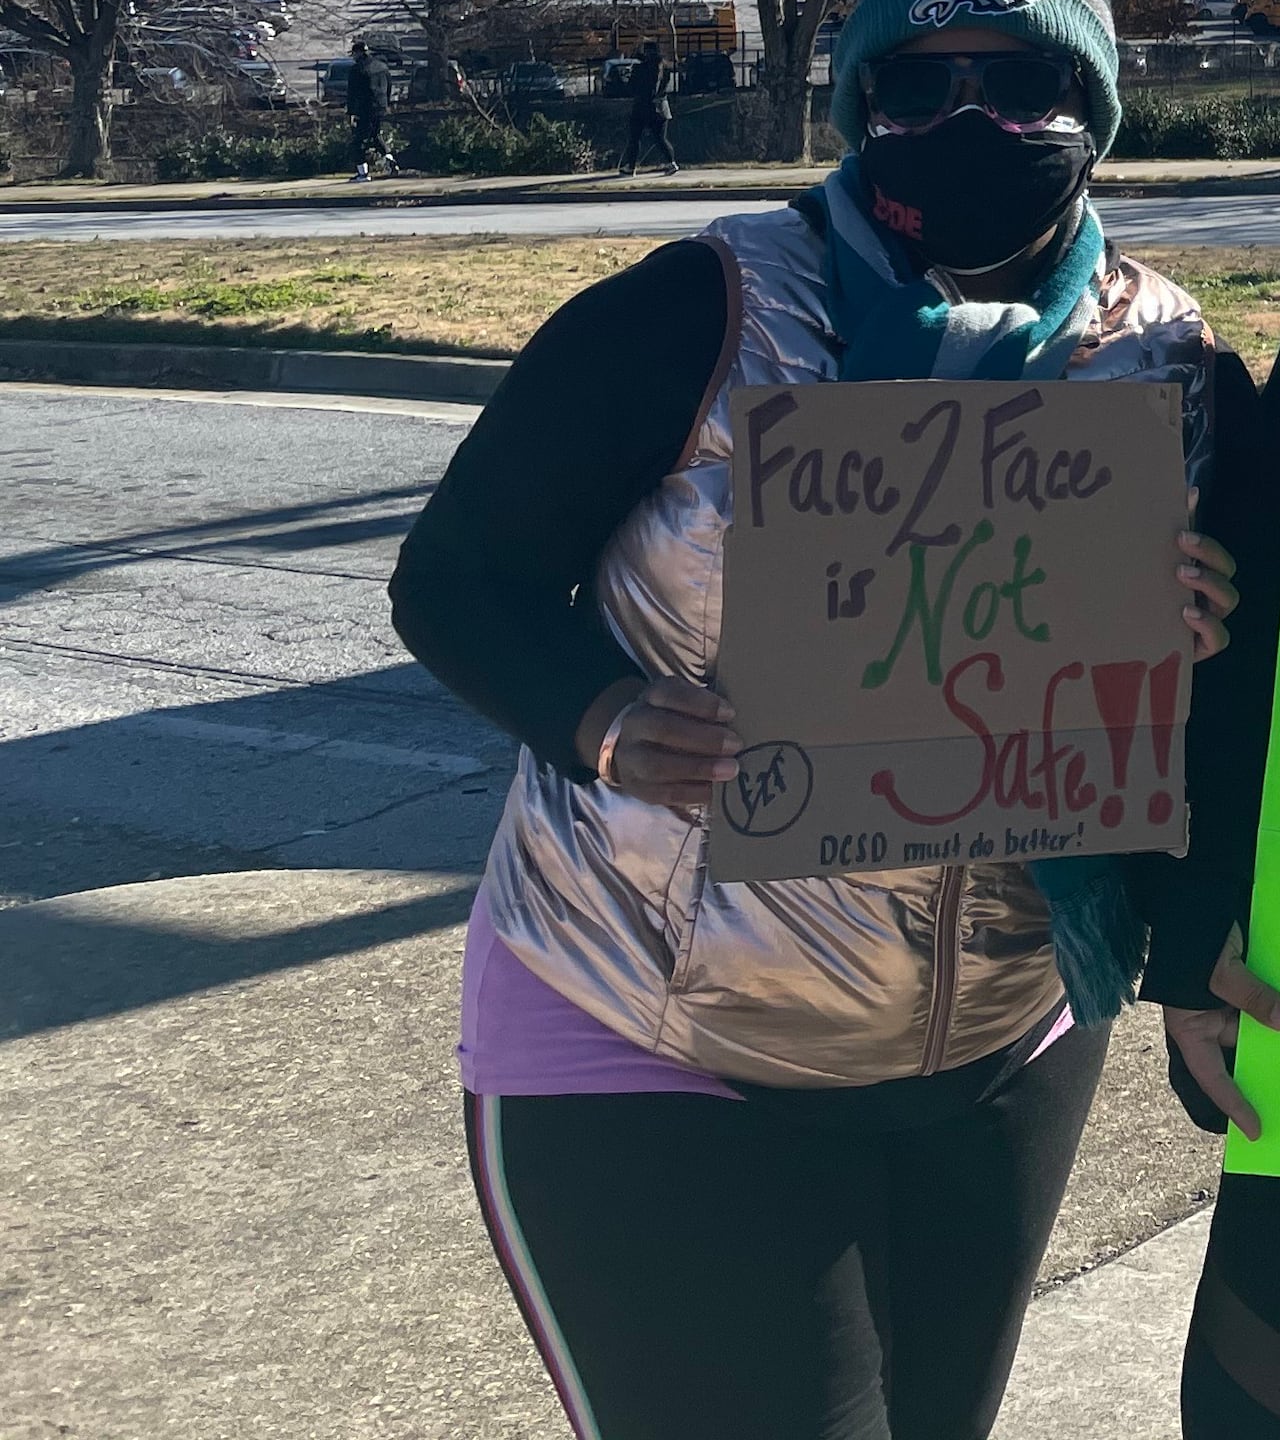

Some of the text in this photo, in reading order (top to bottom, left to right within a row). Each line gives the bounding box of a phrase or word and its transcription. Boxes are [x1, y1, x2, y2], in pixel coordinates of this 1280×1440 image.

[748, 388, 1112, 557] Face 2 Face
[826, 518, 1051, 689] is Not
[870, 650, 1181, 828] Safe!!
[820, 821, 1085, 866] DCSD must do better!
